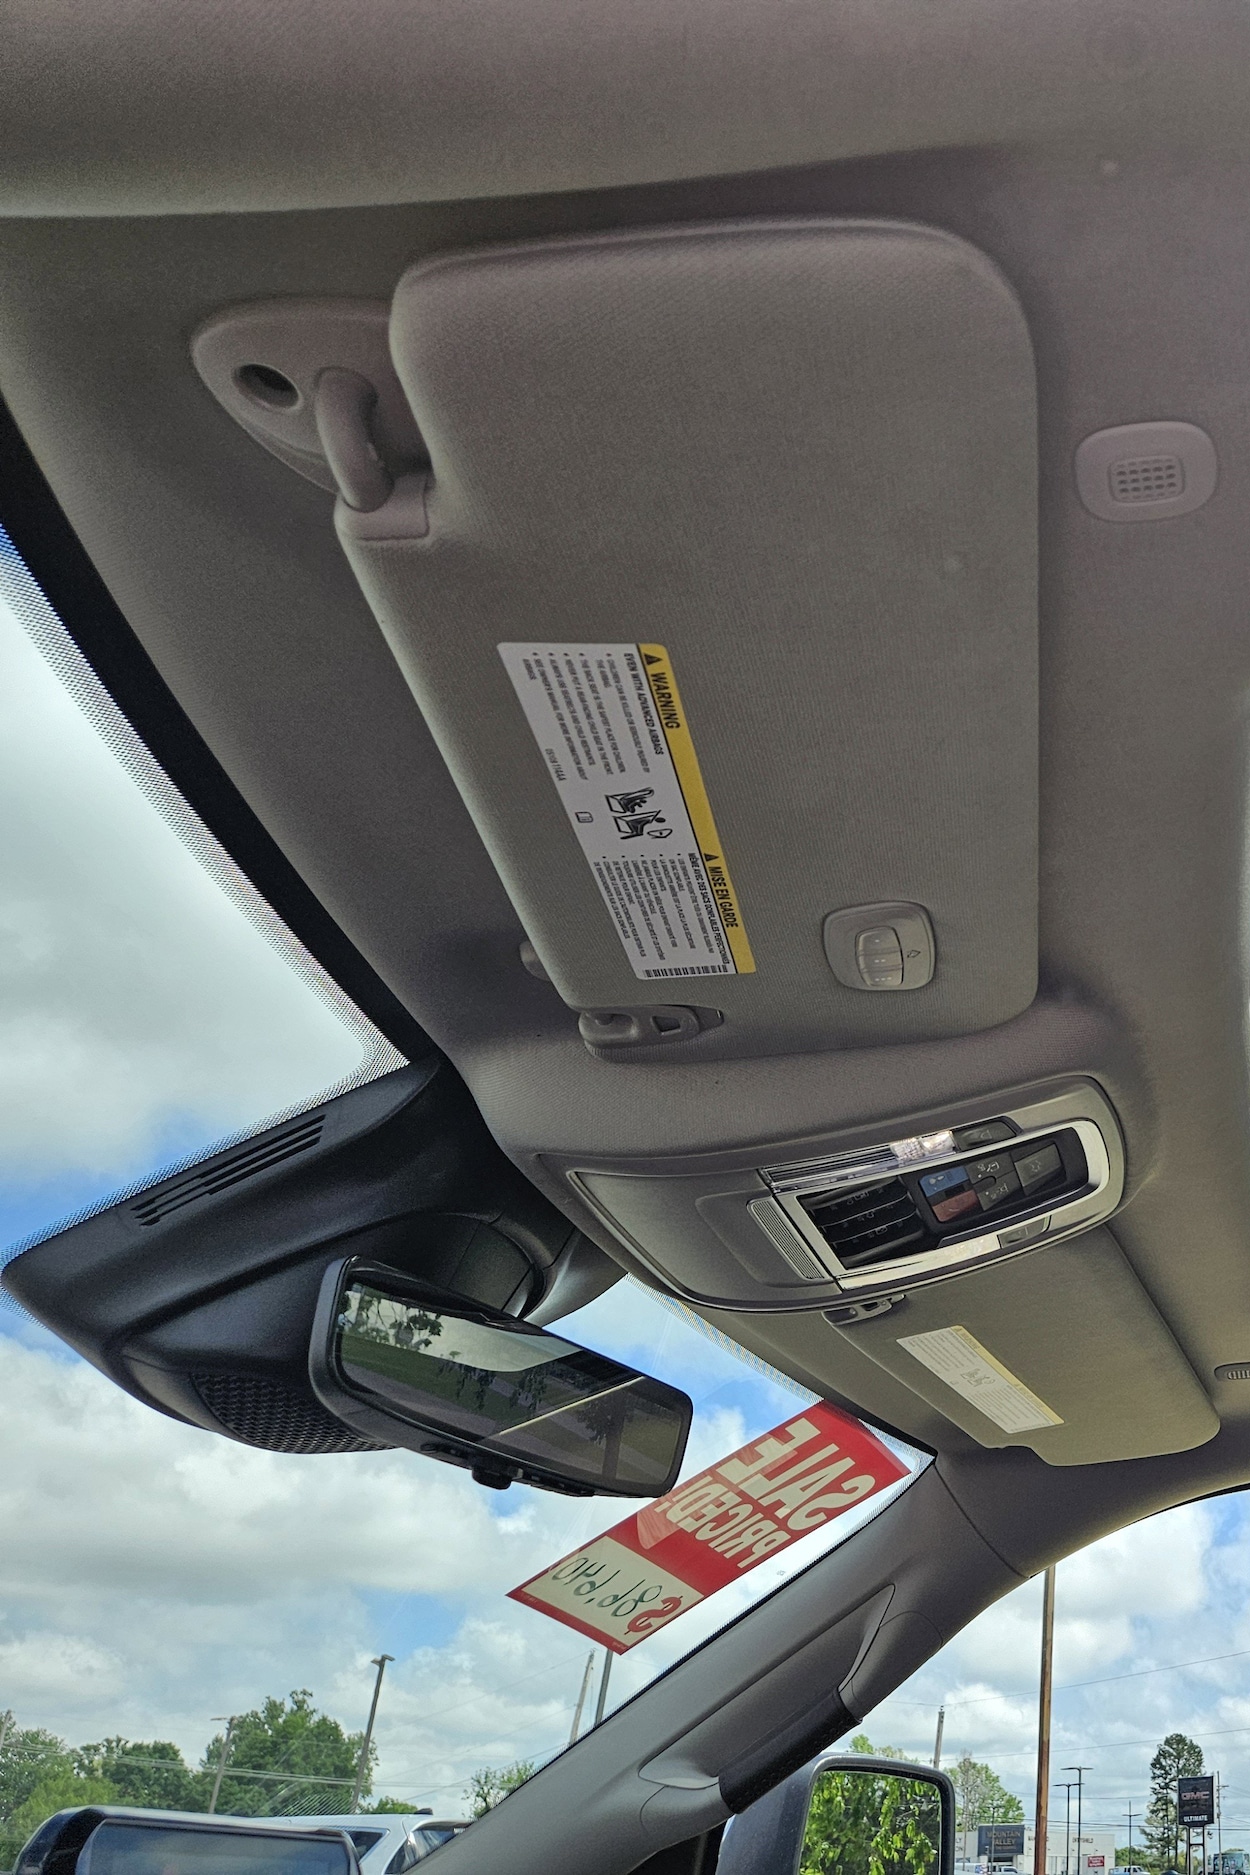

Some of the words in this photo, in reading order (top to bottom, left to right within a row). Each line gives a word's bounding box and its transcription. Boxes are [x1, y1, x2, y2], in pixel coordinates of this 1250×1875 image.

[624, 653, 638, 671] EVEN
[630, 673, 644, 690] WITH
[636, 692, 655, 727] ADVANCED
[650, 672, 680, 728] WARNING
[648, 728, 663, 754] AIRBAGS
[709, 866, 726, 887] MISE
[715, 888, 730, 899] EN
[719, 901, 738, 927] GARDE
[1181, 1790, 1210, 1800] GMC
[1183, 1814, 1208, 1822] ULTIMATE
